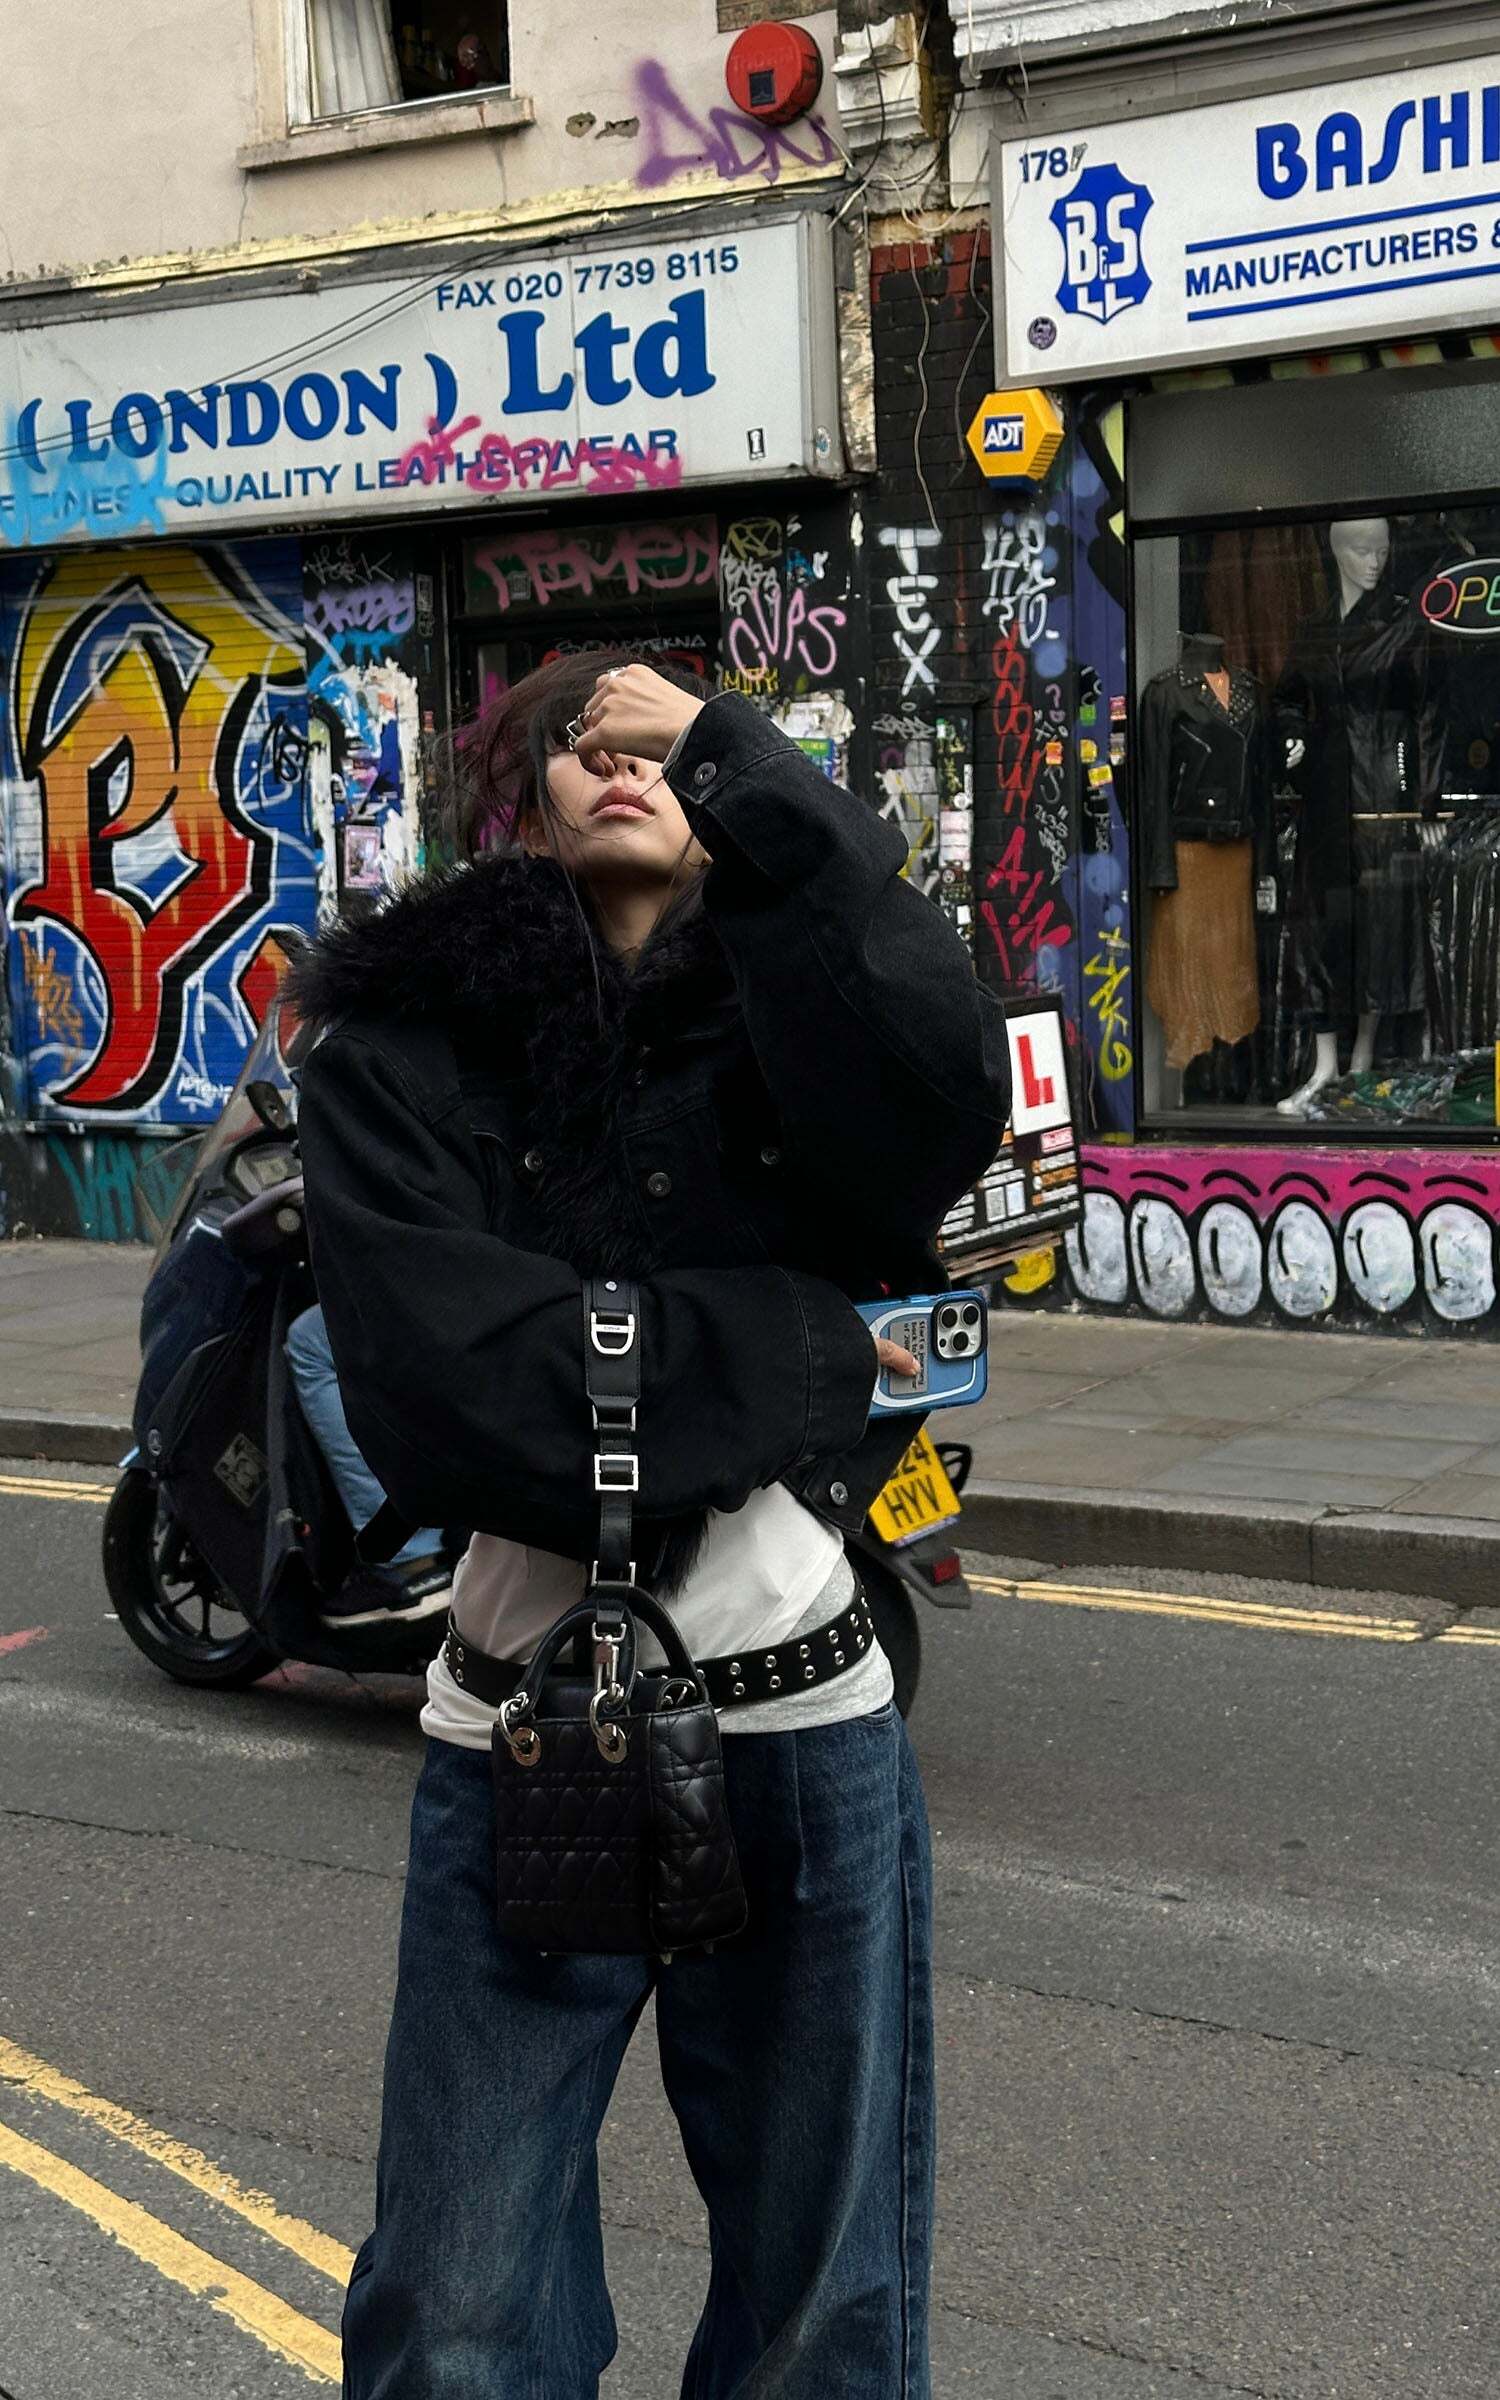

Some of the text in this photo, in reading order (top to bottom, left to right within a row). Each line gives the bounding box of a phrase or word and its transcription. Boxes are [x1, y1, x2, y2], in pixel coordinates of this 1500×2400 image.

[436, 245, 739, 312] FAX 020 7739 8115
[1185, 222, 1479, 297] MANUFACTURERS
[497, 288, 717, 416] Ltd
[984, 418, 1024, 452] ADT
[176, 463, 342, 508] QUALITY
[1016, 1033, 1056, 1109] L
